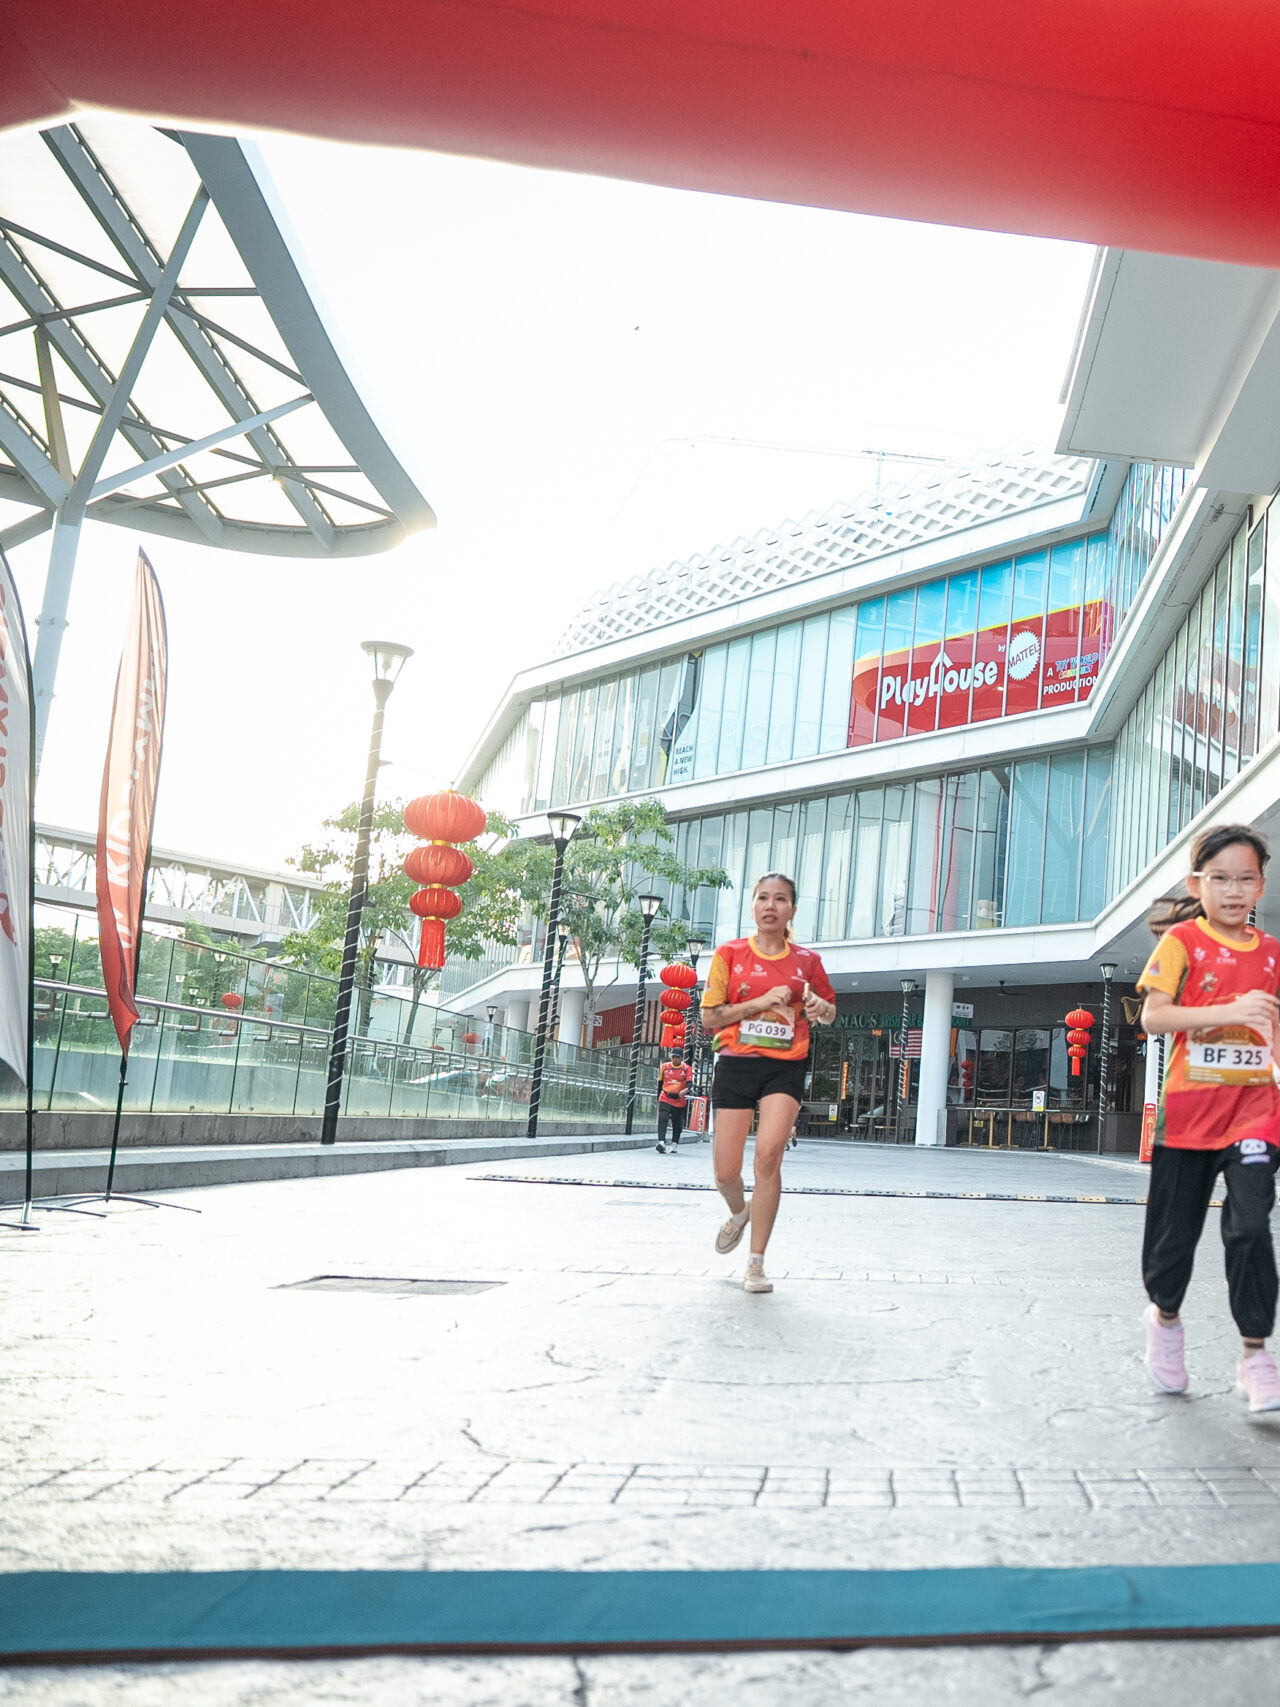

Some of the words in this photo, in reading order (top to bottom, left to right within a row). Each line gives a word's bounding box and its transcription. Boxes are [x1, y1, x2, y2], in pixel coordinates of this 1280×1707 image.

[1008, 643, 1040, 668] MATTEL
[1046, 667, 1054, 677] A
[1055, 659, 1069, 671] TOY
[676, 745, 694, 755] REACH
[680, 756, 692, 764] NEW
[840, 1011, 878, 1028] MAC'S
[748, 1023, 763, 1034] PG
[765, 1025, 787, 1037] 039
[1204, 1047, 1228, 1064] BF
[1233, 1049, 1263, 1065] 325
